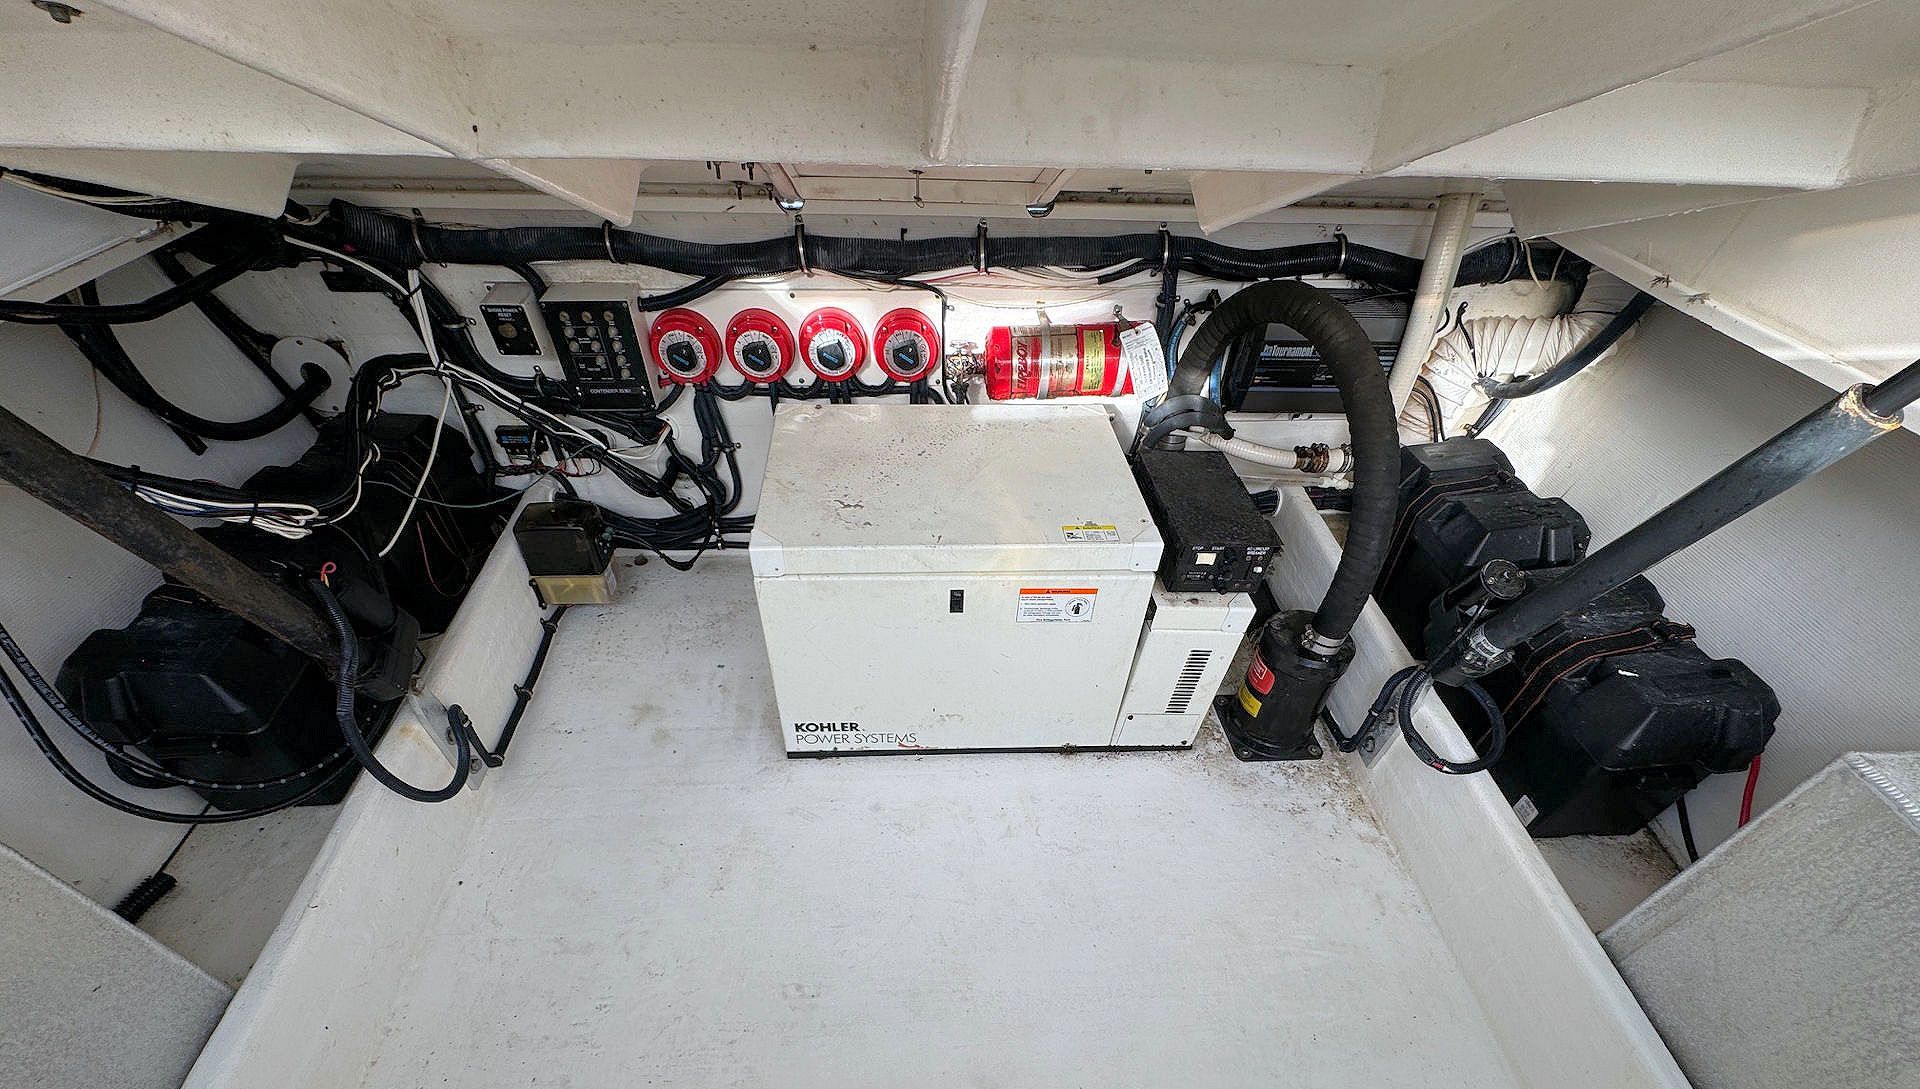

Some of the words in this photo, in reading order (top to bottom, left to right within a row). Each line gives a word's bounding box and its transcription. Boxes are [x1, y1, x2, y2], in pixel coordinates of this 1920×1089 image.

[1016, 339, 1030, 389] FIREBOY
[794, 722, 860, 732] KOHLER
[796, 734, 851, 744] POWER
[854, 733, 917, 744] SYSTEMS
